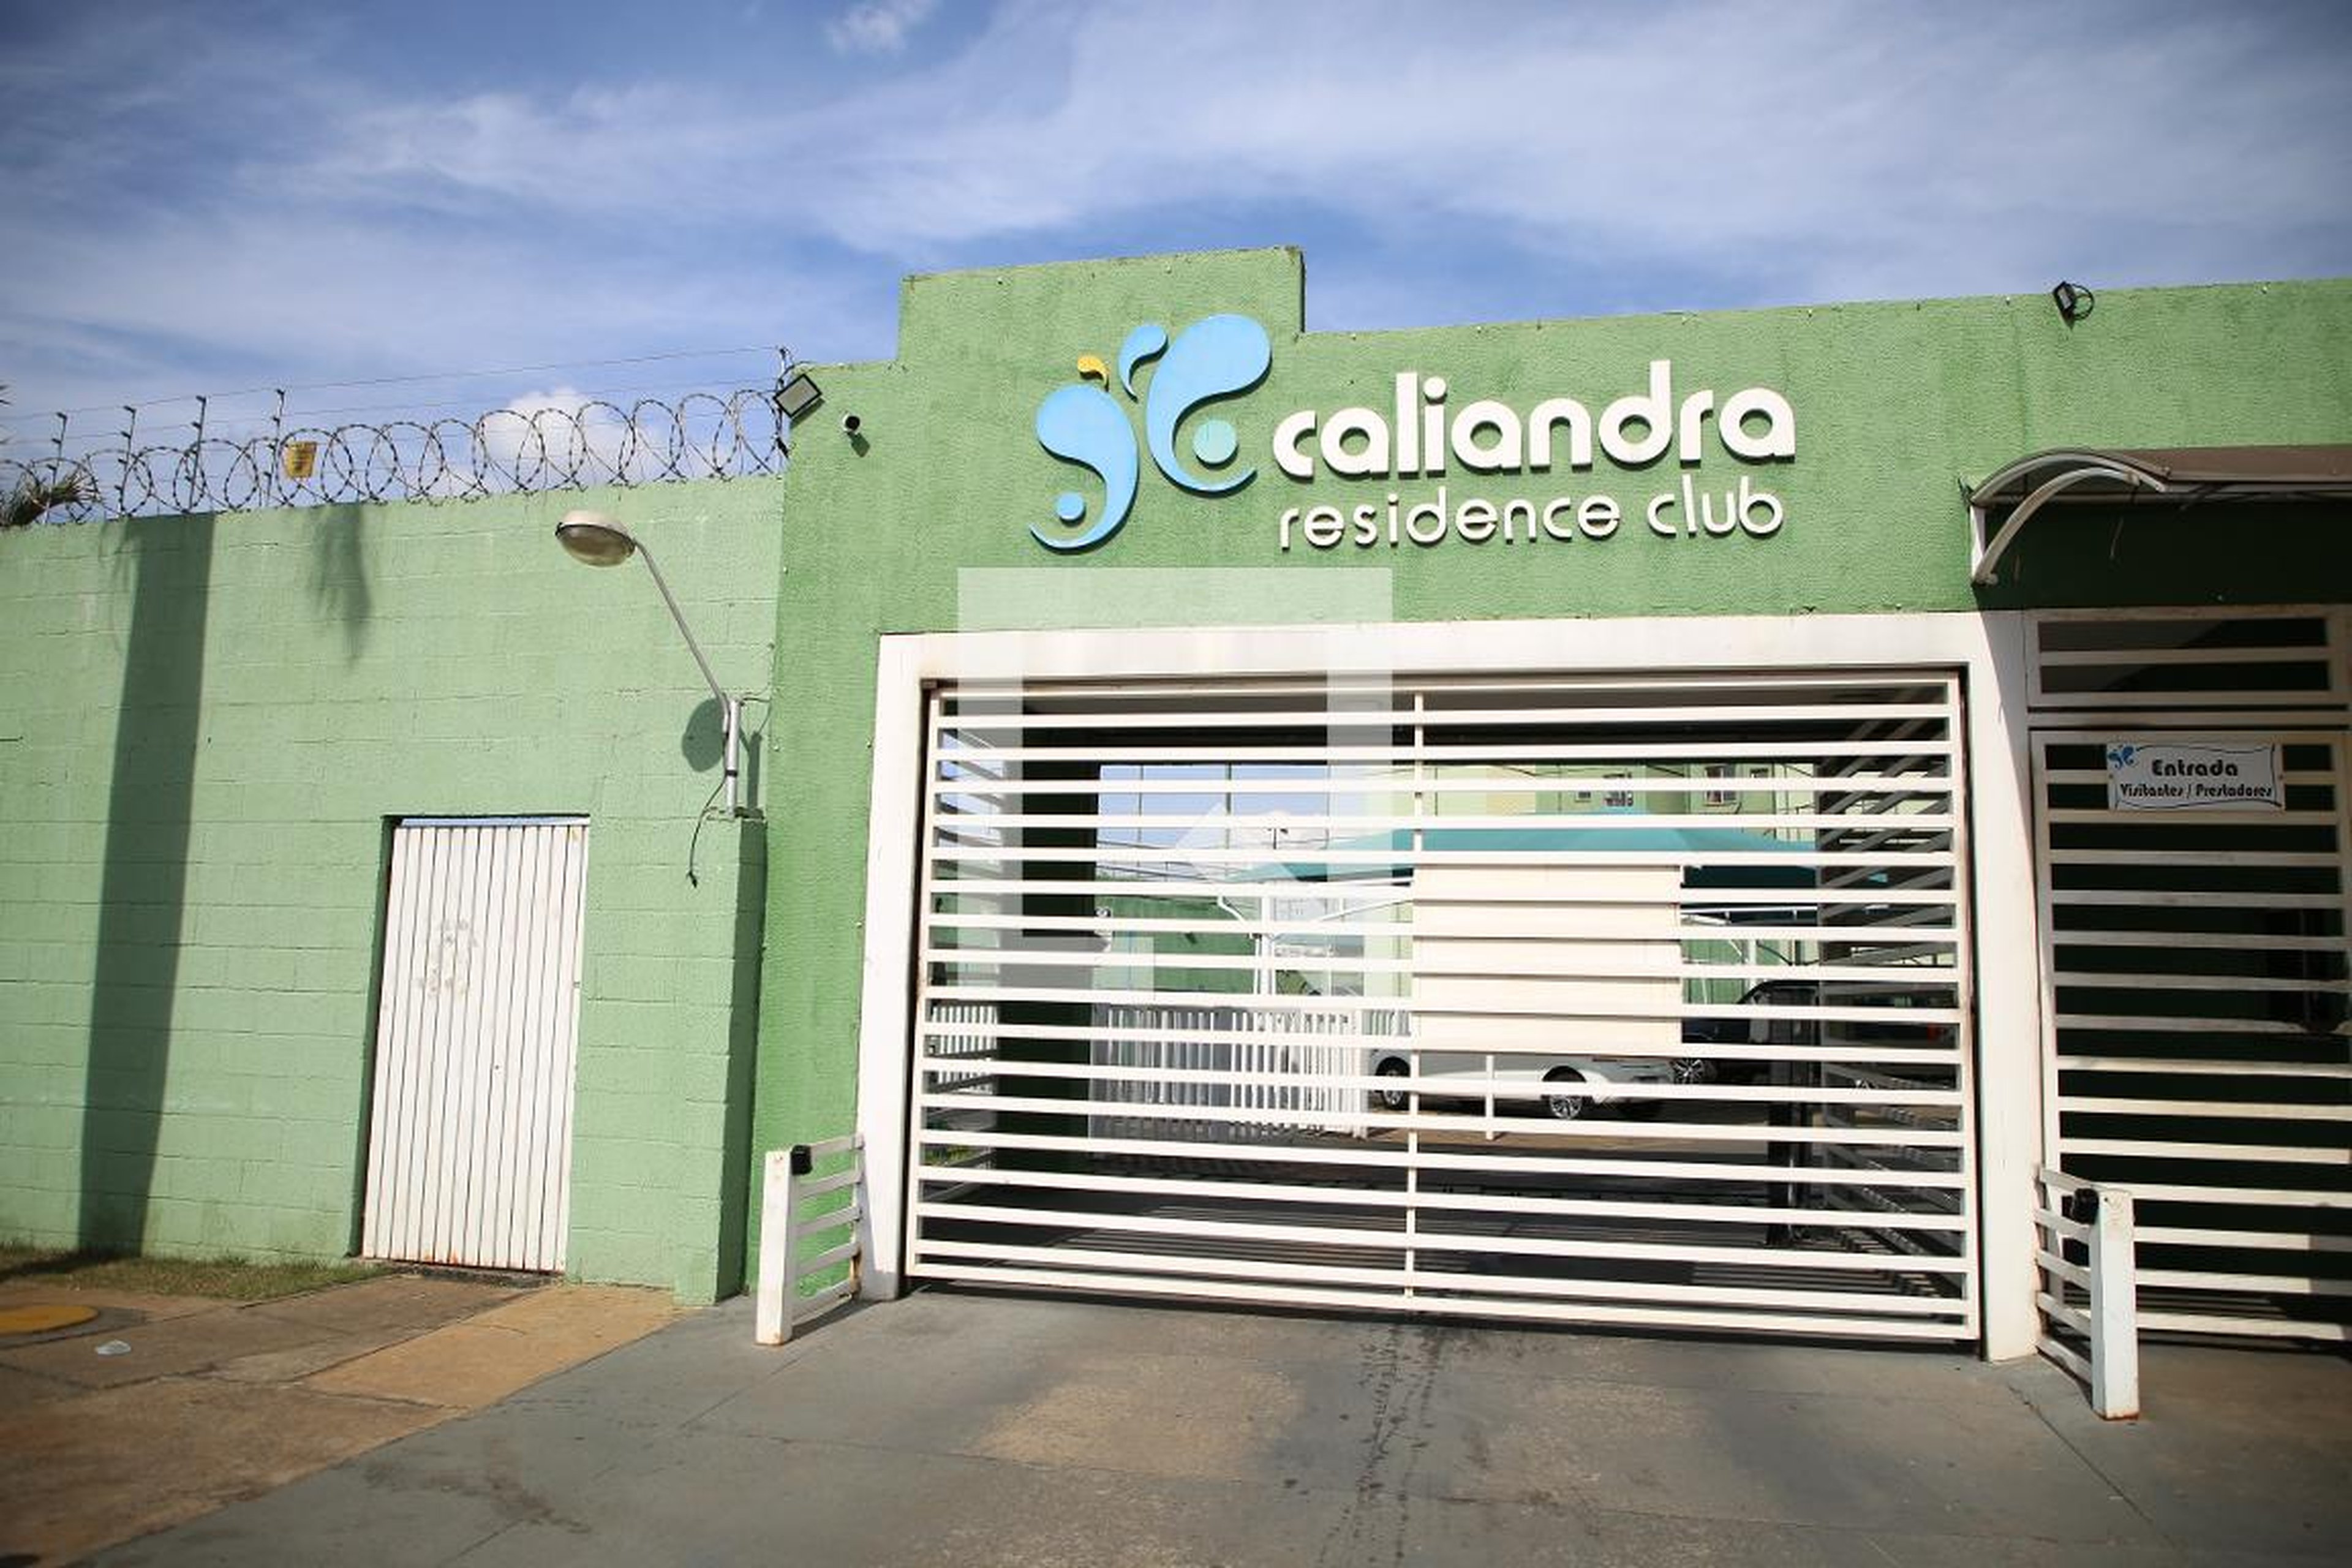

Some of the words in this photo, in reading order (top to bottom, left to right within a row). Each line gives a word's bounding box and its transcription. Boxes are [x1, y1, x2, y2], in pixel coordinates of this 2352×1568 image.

[1272, 360, 1796, 479] caliandra
[1279, 487, 1621, 551] residence
[1646, 474, 1784, 539] club
[2120, 783, 2184, 797] Visitantes
[2196, 783, 2272, 797] Prestadores
[2151, 759, 2238, 777] Entrada
